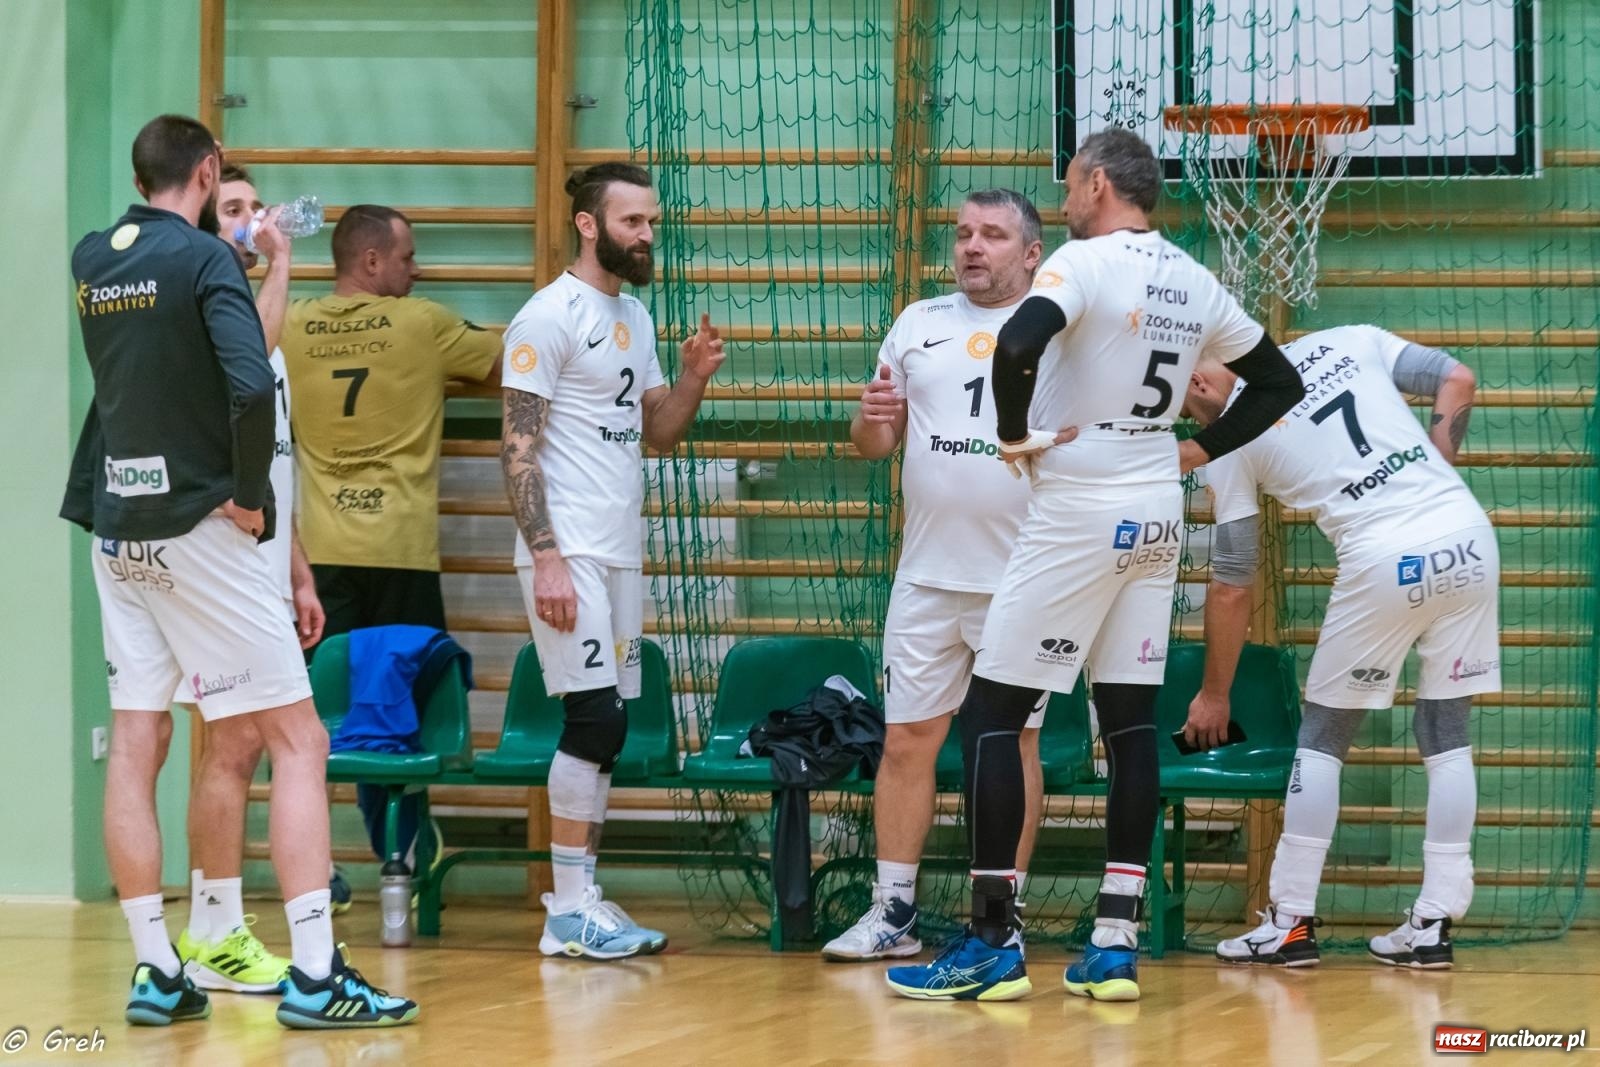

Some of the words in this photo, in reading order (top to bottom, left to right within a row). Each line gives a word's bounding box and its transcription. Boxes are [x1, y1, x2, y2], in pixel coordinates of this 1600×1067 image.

[1103, 80, 1146, 98] SURE
[1102, 112, 1146, 129] SHOT
[91, 296, 156, 315] LUNATYCY
[1146, 285, 1188, 305] PYCIU
[305, 315, 392, 335] GRUSZKA
[1143, 330, 1201, 347] LUNATYCY
[331, 367, 369, 417] 7
[615, 367, 635, 408] 2
[964, 376, 985, 417] 1
[1130, 349, 1180, 419] 5
[1292, 365, 1361, 418] LUNATYCY
[1309, 389, 1373, 458] 7
[1142, 519, 1180, 545] DK
[1115, 545, 1177, 575] glass
[1429, 539, 1482, 575] DK
[108, 557, 175, 590] glass
[1407, 564, 1485, 609] glass
[581, 638, 604, 669] 2
[1037, 651, 1077, 663] wepol
[202, 668, 252, 692] kolgraf
[884, 665, 891, 694] 1
